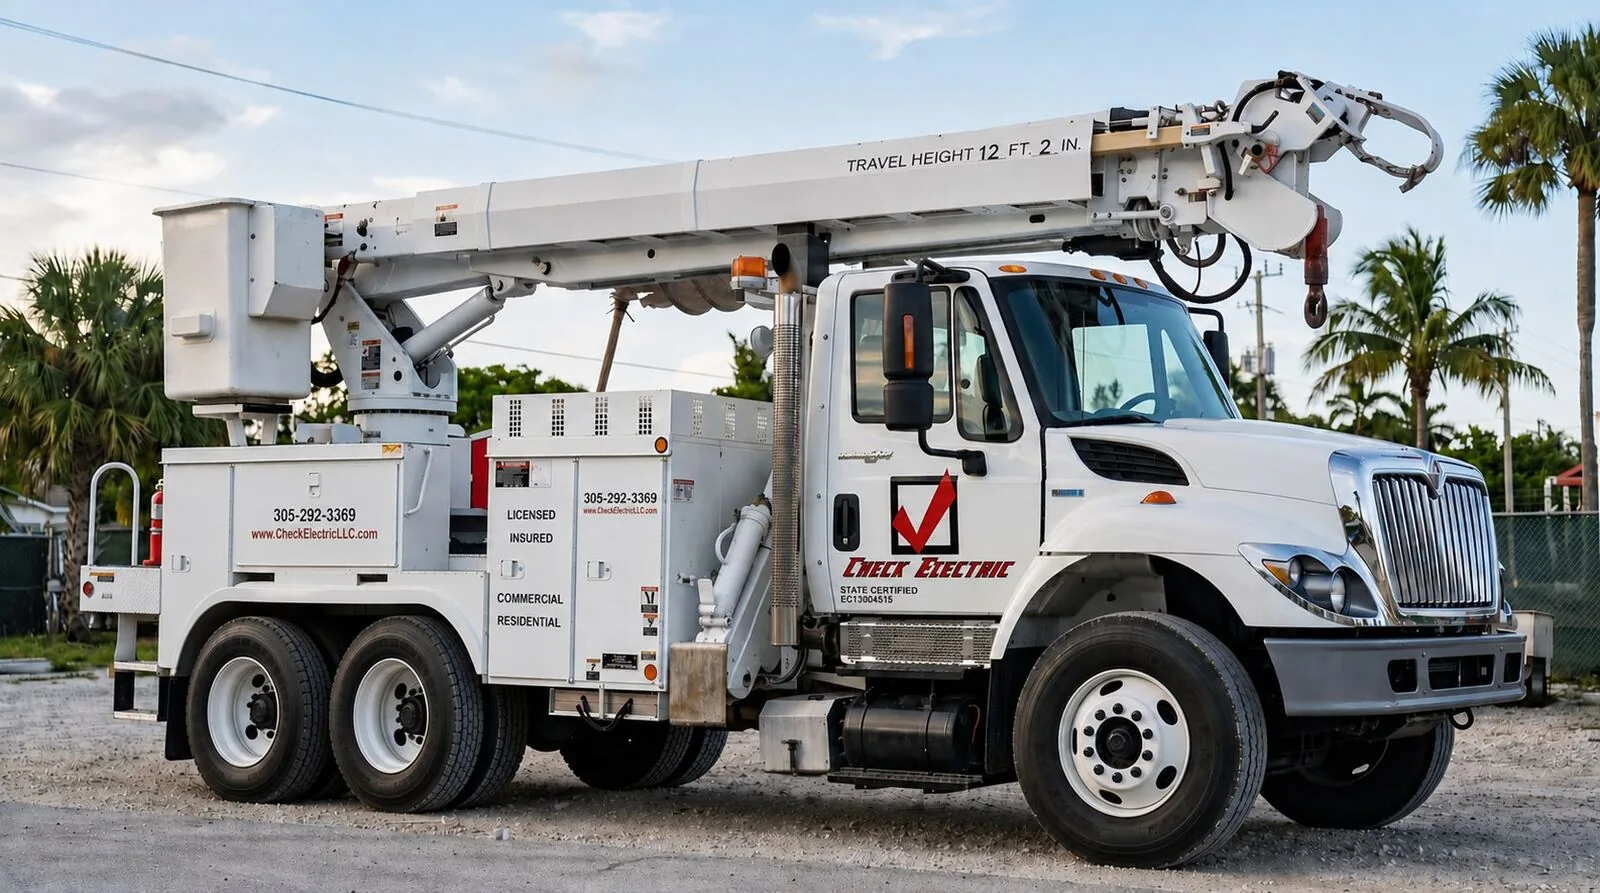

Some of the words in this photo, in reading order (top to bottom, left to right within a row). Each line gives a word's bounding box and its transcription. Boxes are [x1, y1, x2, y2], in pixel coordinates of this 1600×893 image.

[847, 155, 906, 172] TRAVEL
[911, 148, 974, 166] HEIGHT
[978, 143, 1000, 161] 12
[1008, 142, 1032, 156] FT.
[1039, 139, 1051, 156] 2
[1061, 138, 1082, 151] IN.
[584, 492, 657, 504] 305-292-3369
[273, 508, 356, 521] 305-292-3369
[507, 509, 556, 520] LICENSED
[251, 528, 378, 539] www.CheckElectricLLC.com
[510, 533, 553, 543] INSURED
[842, 557, 911, 578] CHECK
[914, 557, 1016, 578] ELECTRIC
[840, 586, 868, 594] STATE
[870, 586, 918, 595] CERTIFIED
[497, 593, 564, 604] COMMERCIAL
[497, 616, 561, 628] RESIDENTIAL
